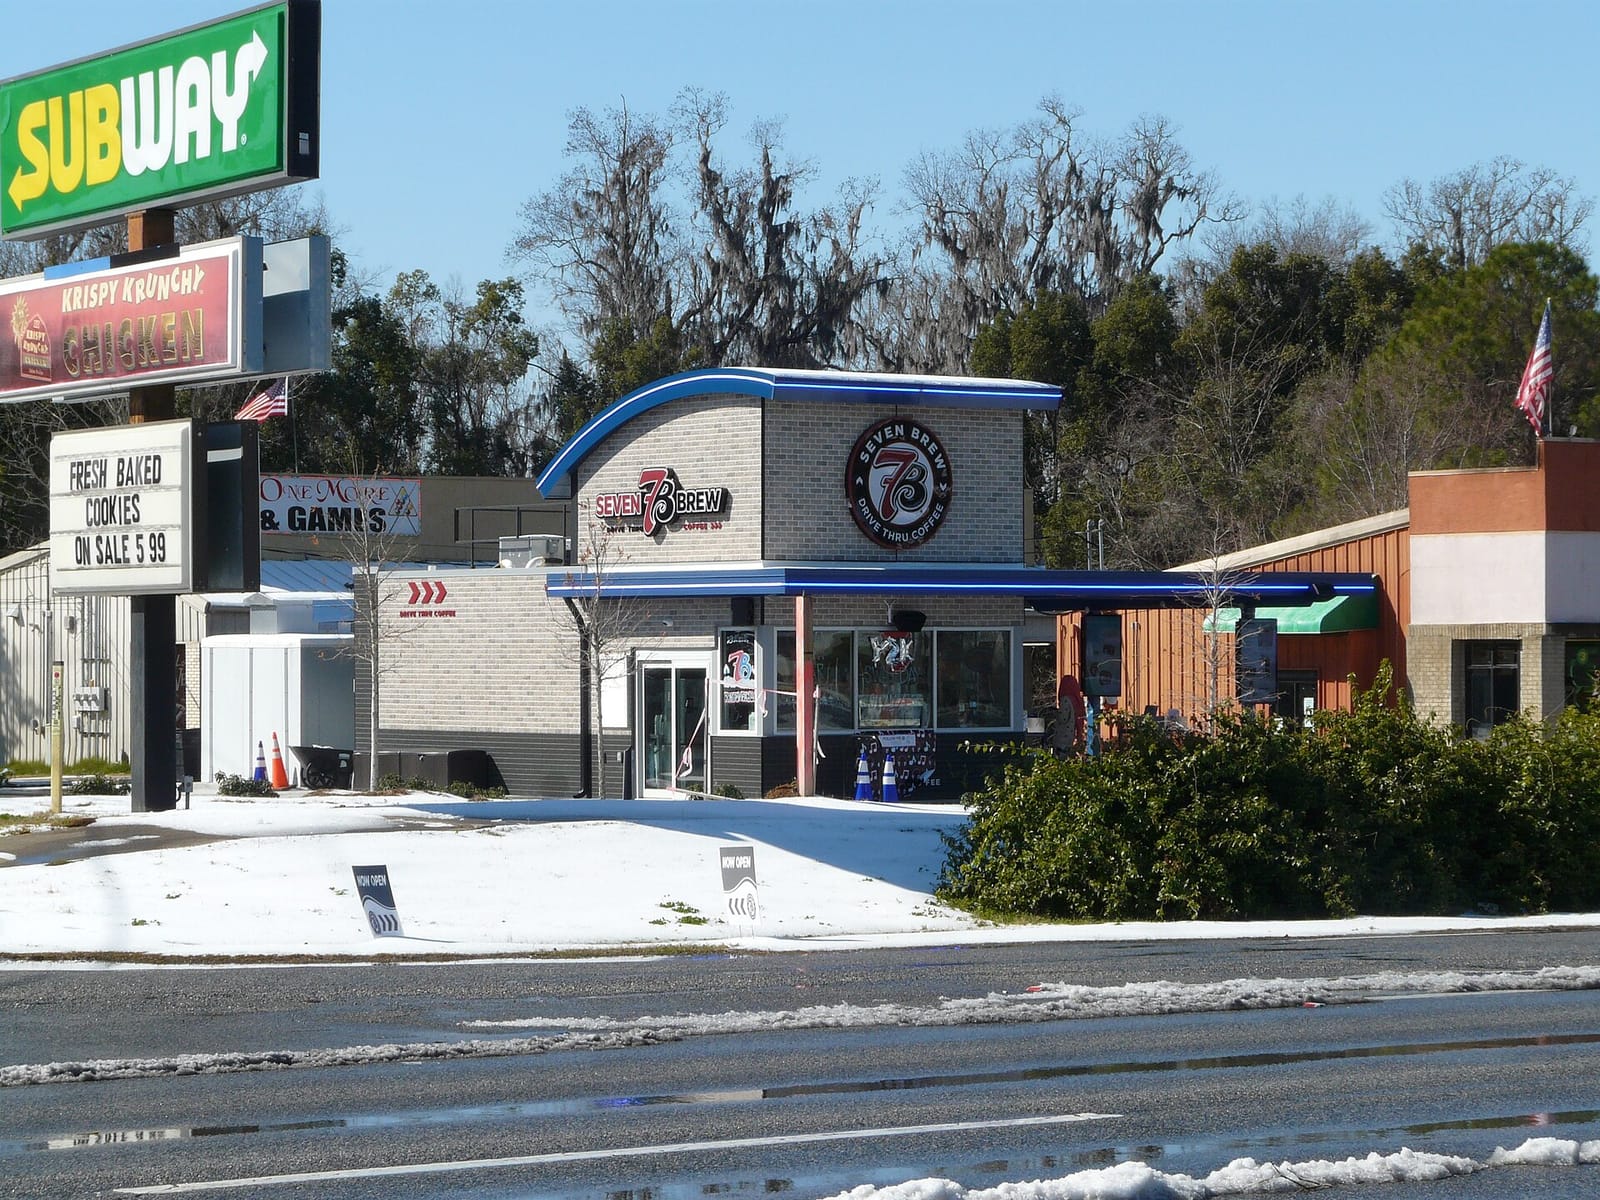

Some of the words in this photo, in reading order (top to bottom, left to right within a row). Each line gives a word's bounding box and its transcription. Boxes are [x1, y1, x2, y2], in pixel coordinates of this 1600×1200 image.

[8, 28, 268, 213] SUBWAY
[62, 279, 118, 312] KRISPY
[122, 264, 205, 304] KRUNCHY
[63, 308, 204, 377] CHICKEN
[860, 424, 904, 463] SEVEN
[911, 427, 946, 470] BREW
[70, 459, 107, 490] FRESH
[116, 455, 162, 487] BAKED
[86, 494, 140, 526] COOKIES
[596, 493, 642, 517] SEVEN
[676, 488, 722, 514] BREW
[858, 497, 882, 532] DRIVE
[882, 528, 909, 542] THRU
[911, 503, 944, 539] COFFEE
[260, 509, 280, 531] &
[75, 536, 91, 565] ON
[96, 535, 130, 564] SALE
[136, 534, 144, 563] 5
[149, 532, 166, 562] 99
[722, 855, 735, 869] NOW
[735, 855, 751, 869] OPEN
[357, 874, 370, 887] NOW
[371, 874, 387, 887] OPEN
